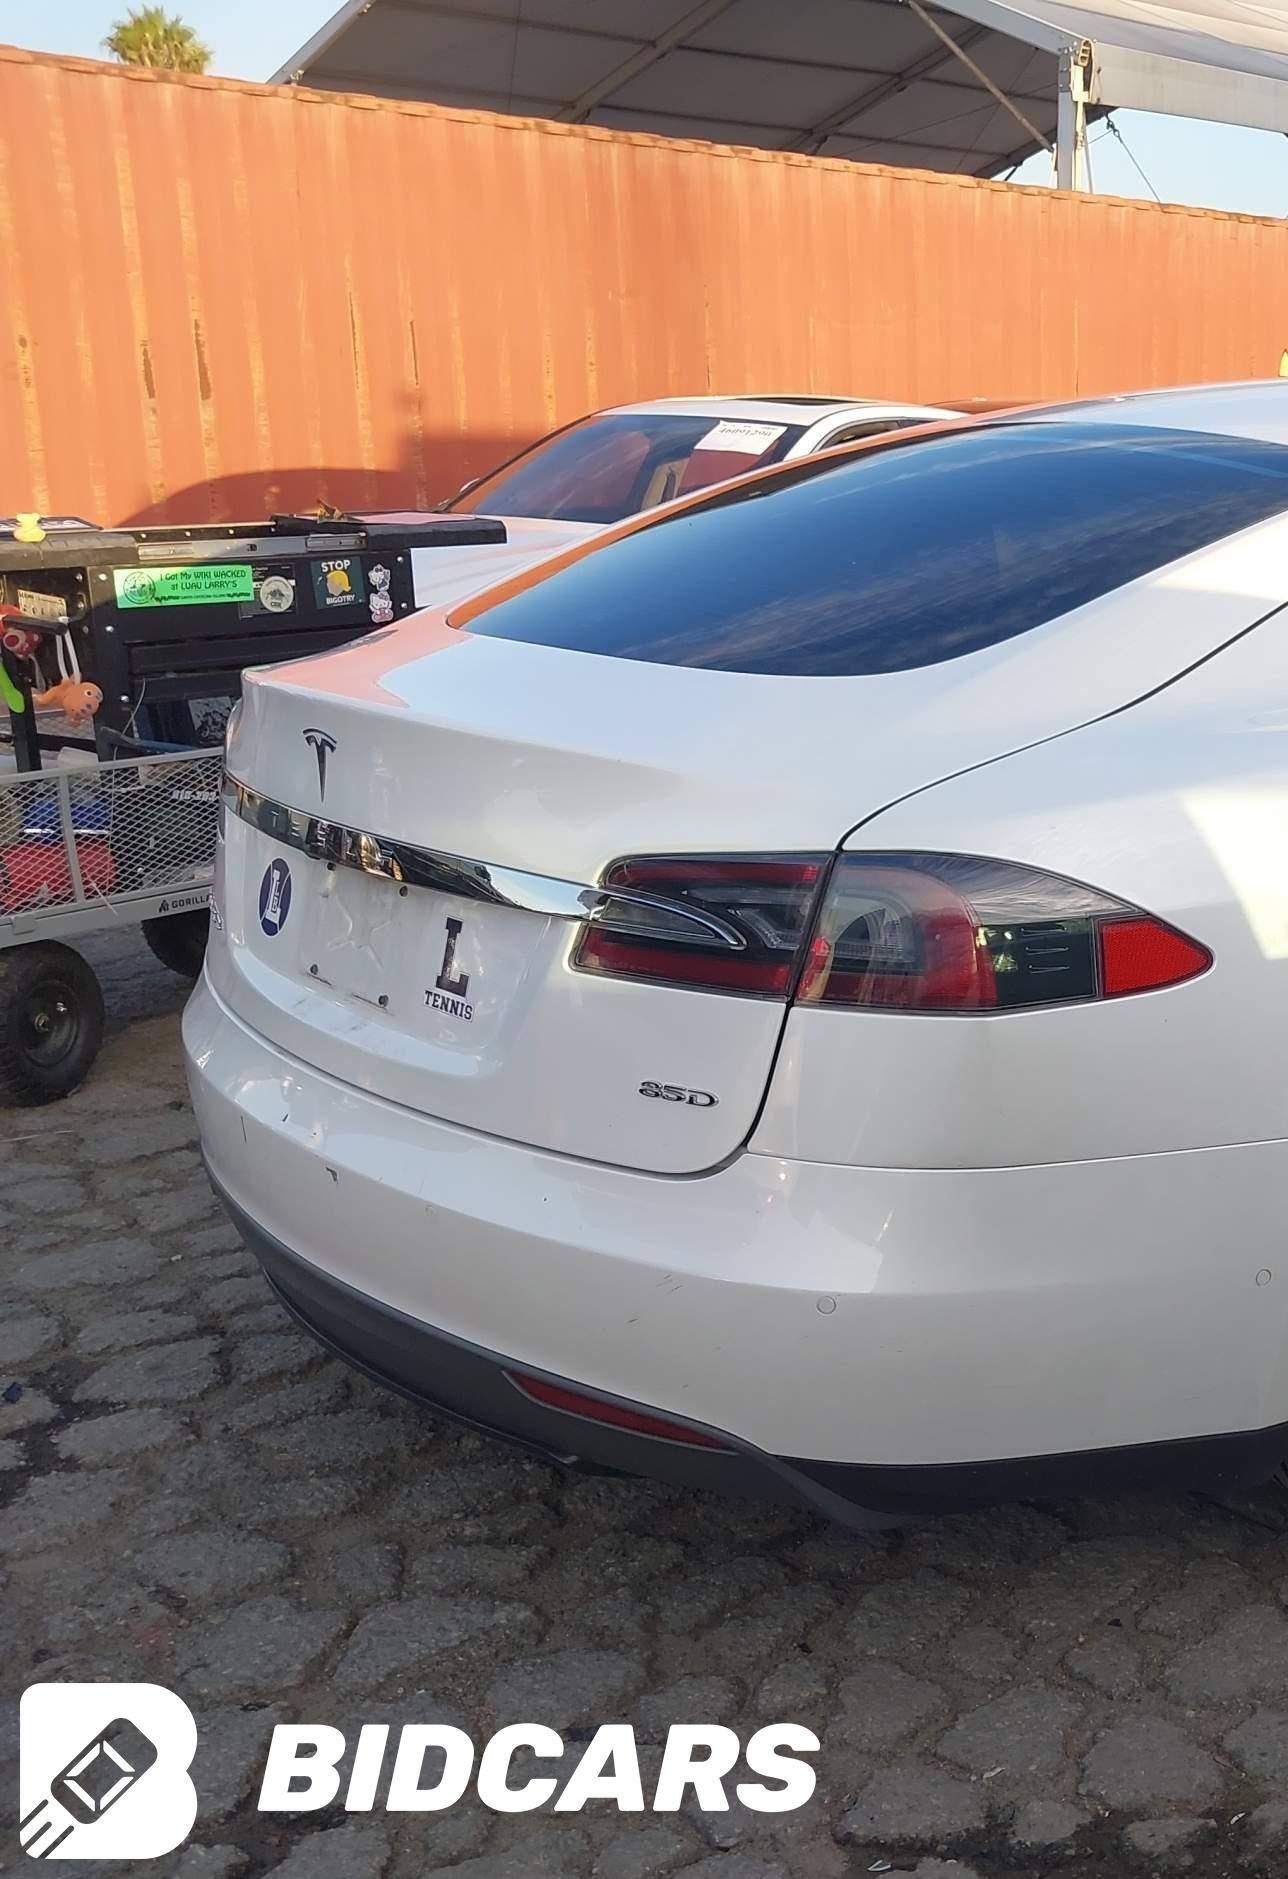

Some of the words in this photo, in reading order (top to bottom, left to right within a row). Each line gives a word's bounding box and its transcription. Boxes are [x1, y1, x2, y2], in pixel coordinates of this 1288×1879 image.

[321, 560, 351, 572] STOP
[180, 572, 192, 580] My
[326, 594, 355, 605] BIGOTRY
[436, 917, 470, 997] L
[425, 990, 473, 1020] TENNIS
[639, 1081, 719, 1107] 85D
